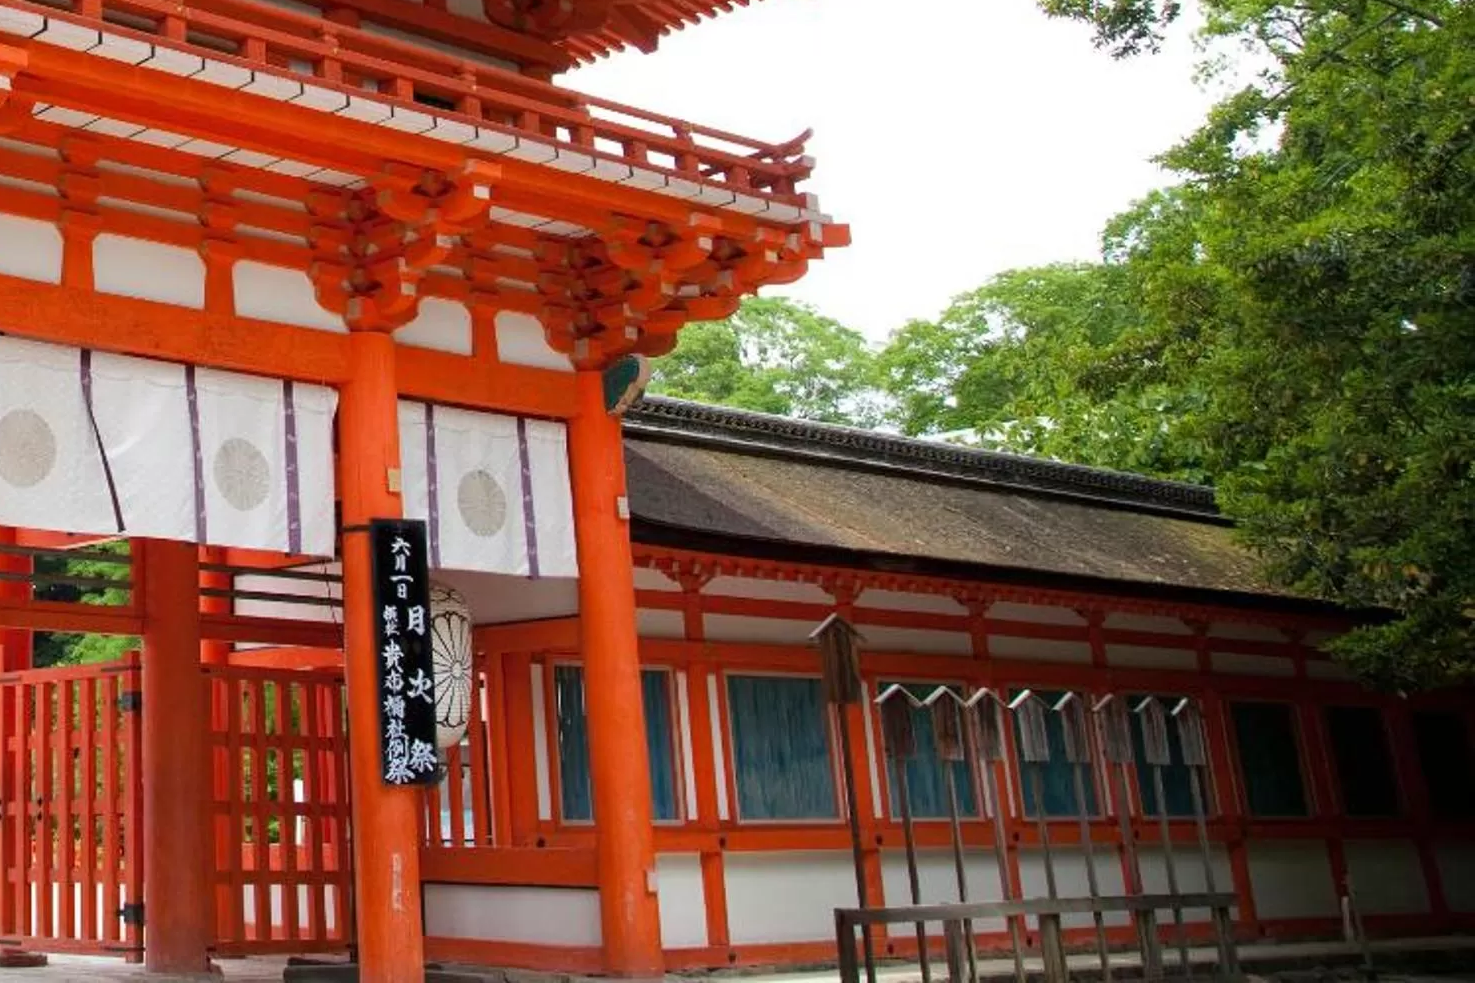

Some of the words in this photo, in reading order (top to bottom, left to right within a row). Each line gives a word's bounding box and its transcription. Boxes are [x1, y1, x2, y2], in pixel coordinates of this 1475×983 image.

[389, 536, 414, 599] 六月一日
[406, 604, 437, 773] 月次祭
